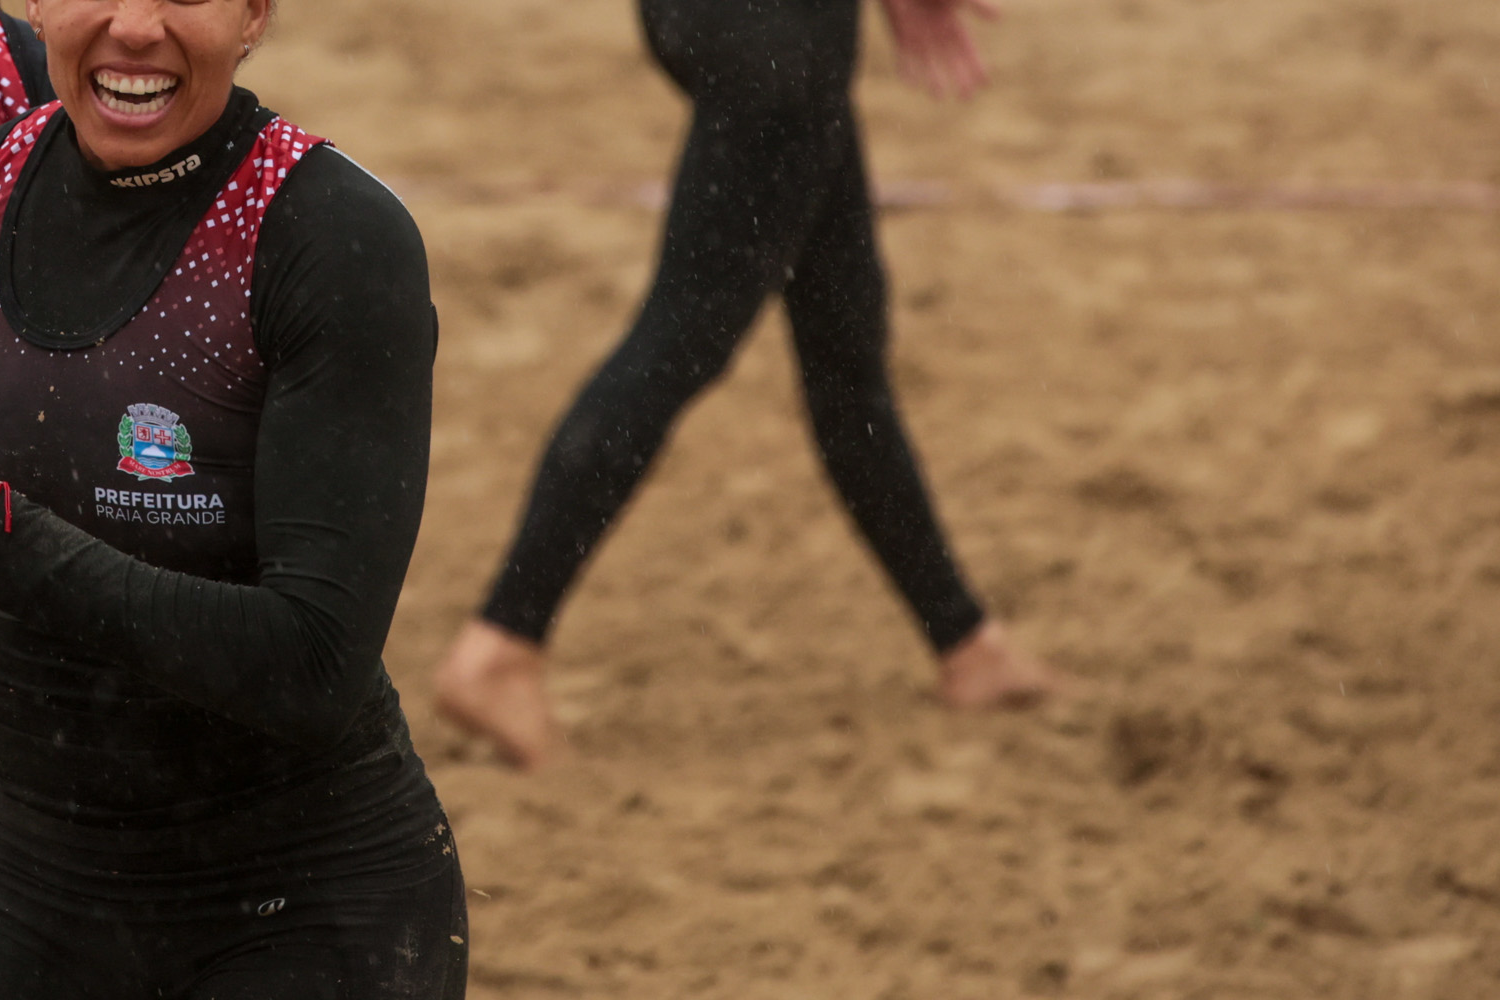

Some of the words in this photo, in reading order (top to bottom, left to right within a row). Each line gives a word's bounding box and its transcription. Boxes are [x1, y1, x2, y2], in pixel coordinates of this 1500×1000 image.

[94, 487, 224, 510] PREFEITURA
[96, 504, 143, 523] PRAIA
[146, 510, 226, 525] GRANDE
